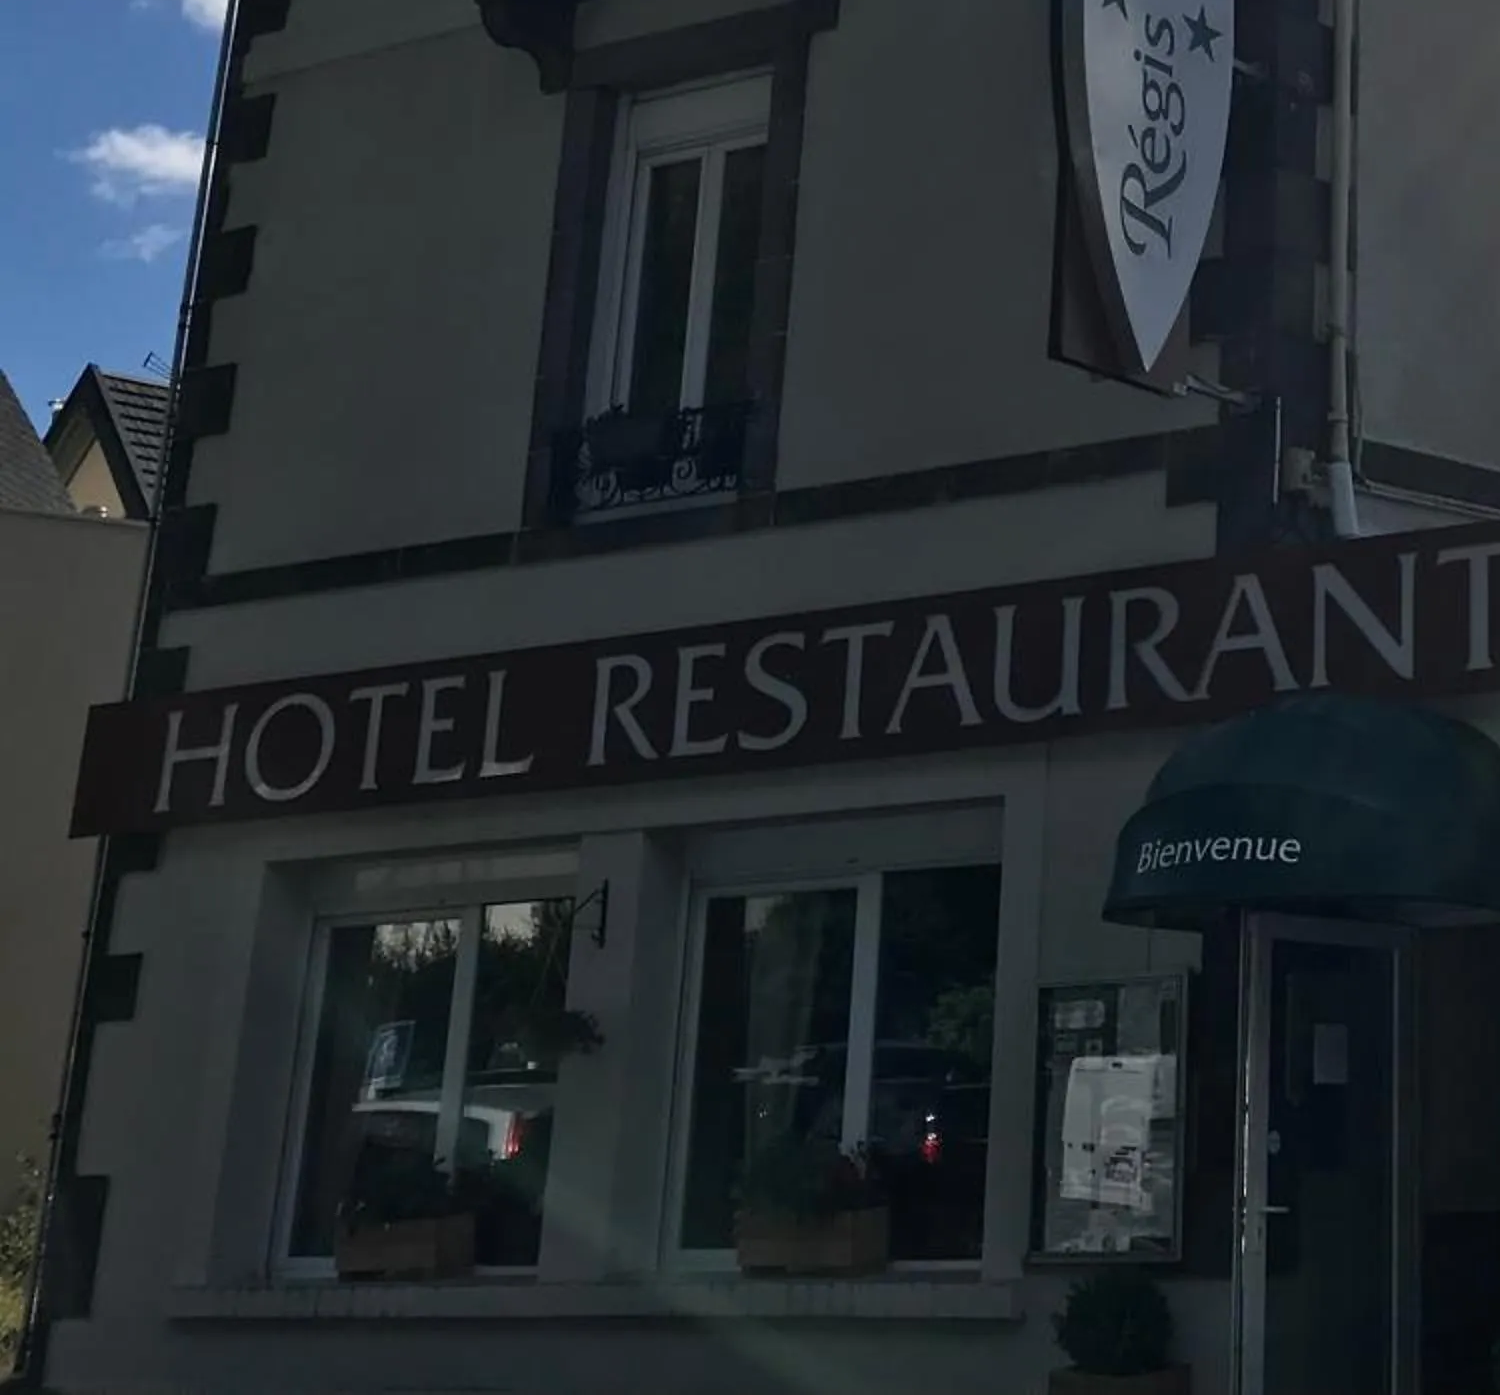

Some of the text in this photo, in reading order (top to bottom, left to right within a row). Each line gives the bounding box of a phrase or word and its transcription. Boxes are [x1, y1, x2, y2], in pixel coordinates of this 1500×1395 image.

[1118, 11, 1187, 261] Régis
[152, 669, 535, 814] HOTEL
[1136, 835, 1301, 874] Bienvenue
